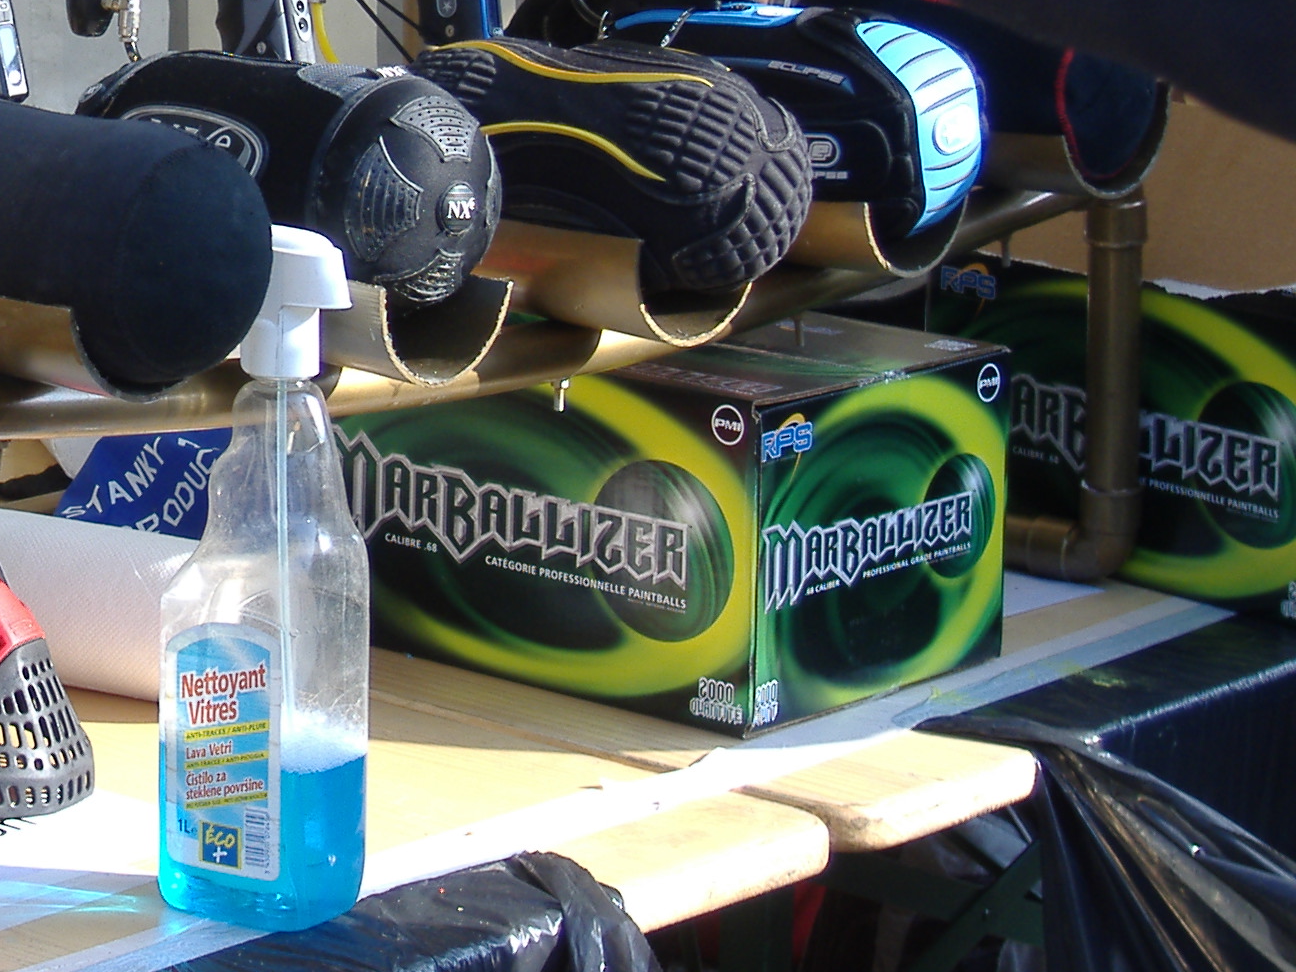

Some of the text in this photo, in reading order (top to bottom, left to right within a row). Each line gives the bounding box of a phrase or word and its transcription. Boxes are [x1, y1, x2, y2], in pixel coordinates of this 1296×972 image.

[767, 60, 844, 85] ECLIPSE
[940, 265, 996, 300] RPS
[714, 417, 742, 432] PMI
[761, 421, 814, 463] RPS
[61, 436, 164, 519] STANKY
[1148, 480, 1224, 505] PROFESSIONNELLE
[1227, 498, 1279, 519] PAINTBALLS
[385, 532, 438, 554] CALIBRE .68
[762, 490, 972, 615] MARBALLIZER
[863, 559, 909, 578] PROFESSIONAL
[910, 551, 932, 565] GRADE
[933, 542, 971, 558] PAINTBALLS
[539, 567, 626, 596] PROFESSIONNELLE
[628, 587, 687, 610] PAINTBALLS
[815, 579, 840, 594] CALIBER
[181, 662, 266, 699] Nettoyant
[699, 677, 735, 706] 2000
[189, 697, 237, 725] Vitres
[186, 740, 232, 760] Lava Vetri
[186, 770, 227, 787] Čistilo za
[186, 785, 222, 801] steklene
